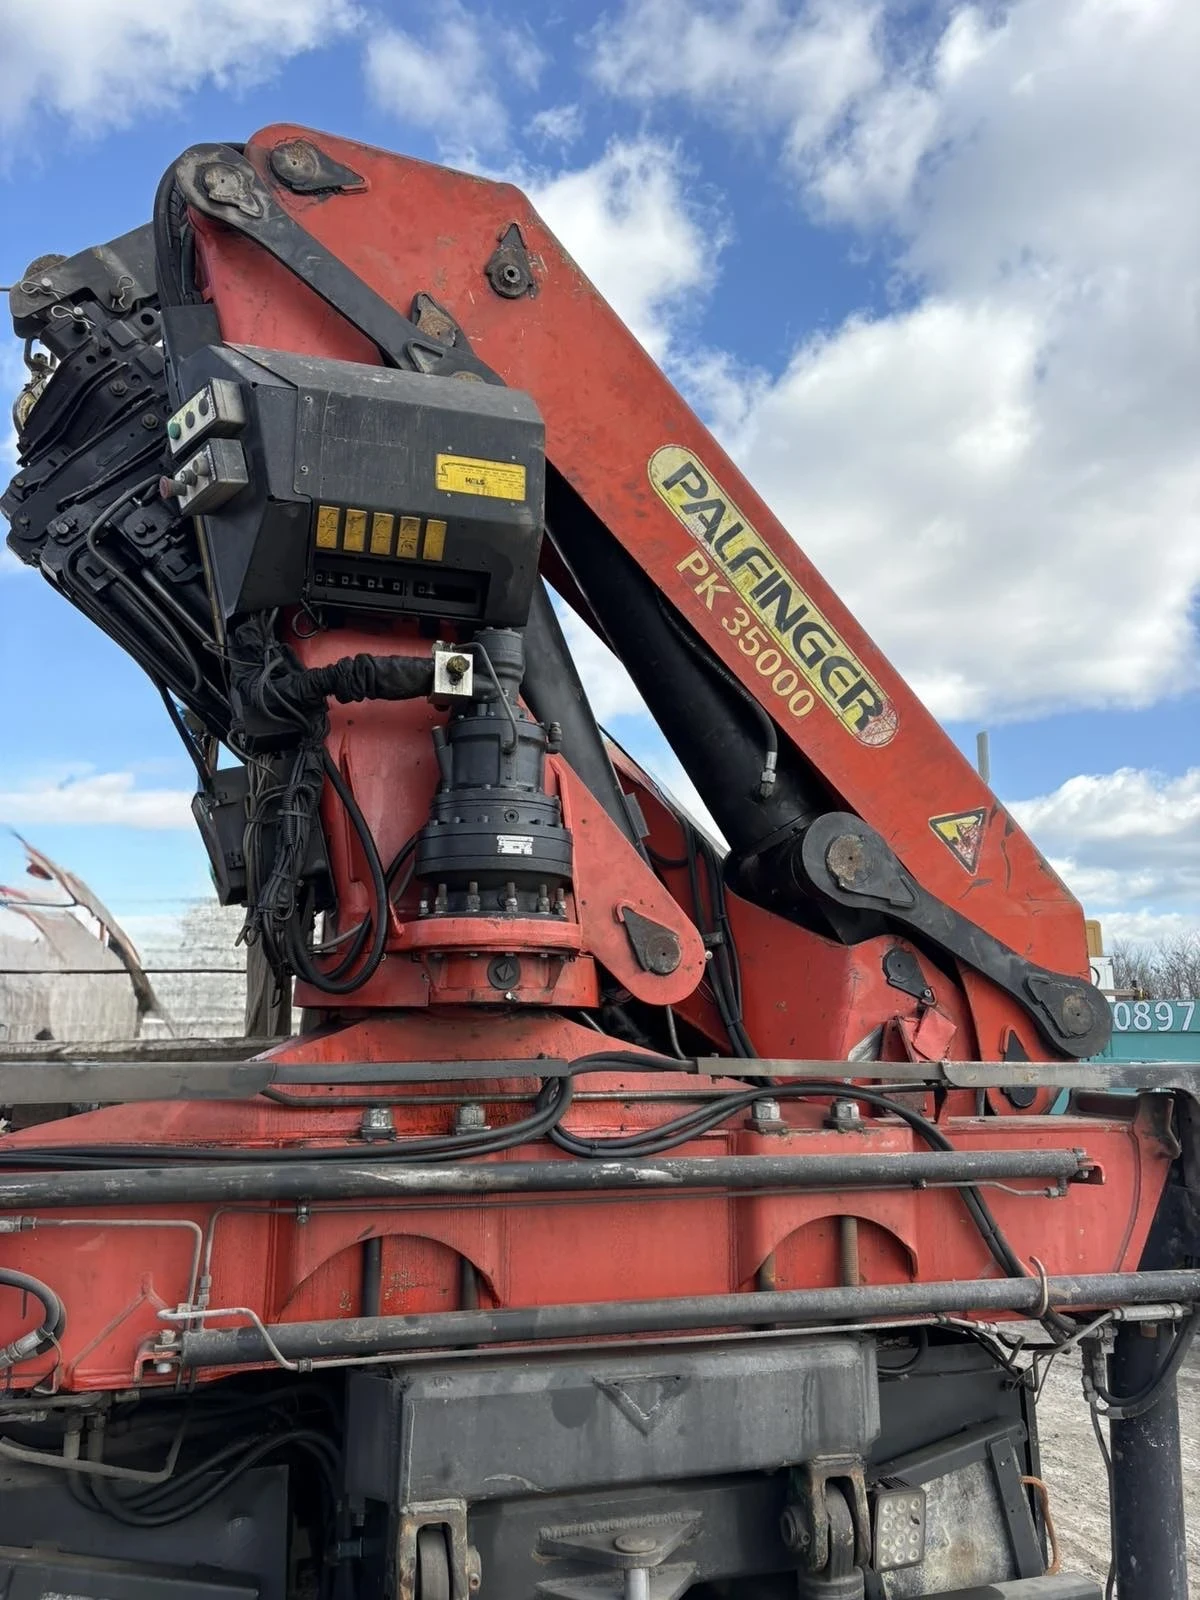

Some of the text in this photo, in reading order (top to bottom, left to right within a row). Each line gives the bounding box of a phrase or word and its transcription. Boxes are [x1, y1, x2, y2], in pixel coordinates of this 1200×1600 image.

[662, 461, 884, 732] PALFINGER
[675, 549, 731, 611] PK
[721, 606, 816, 718] 35000
[1113, 1001, 1196, 1031] 0897
